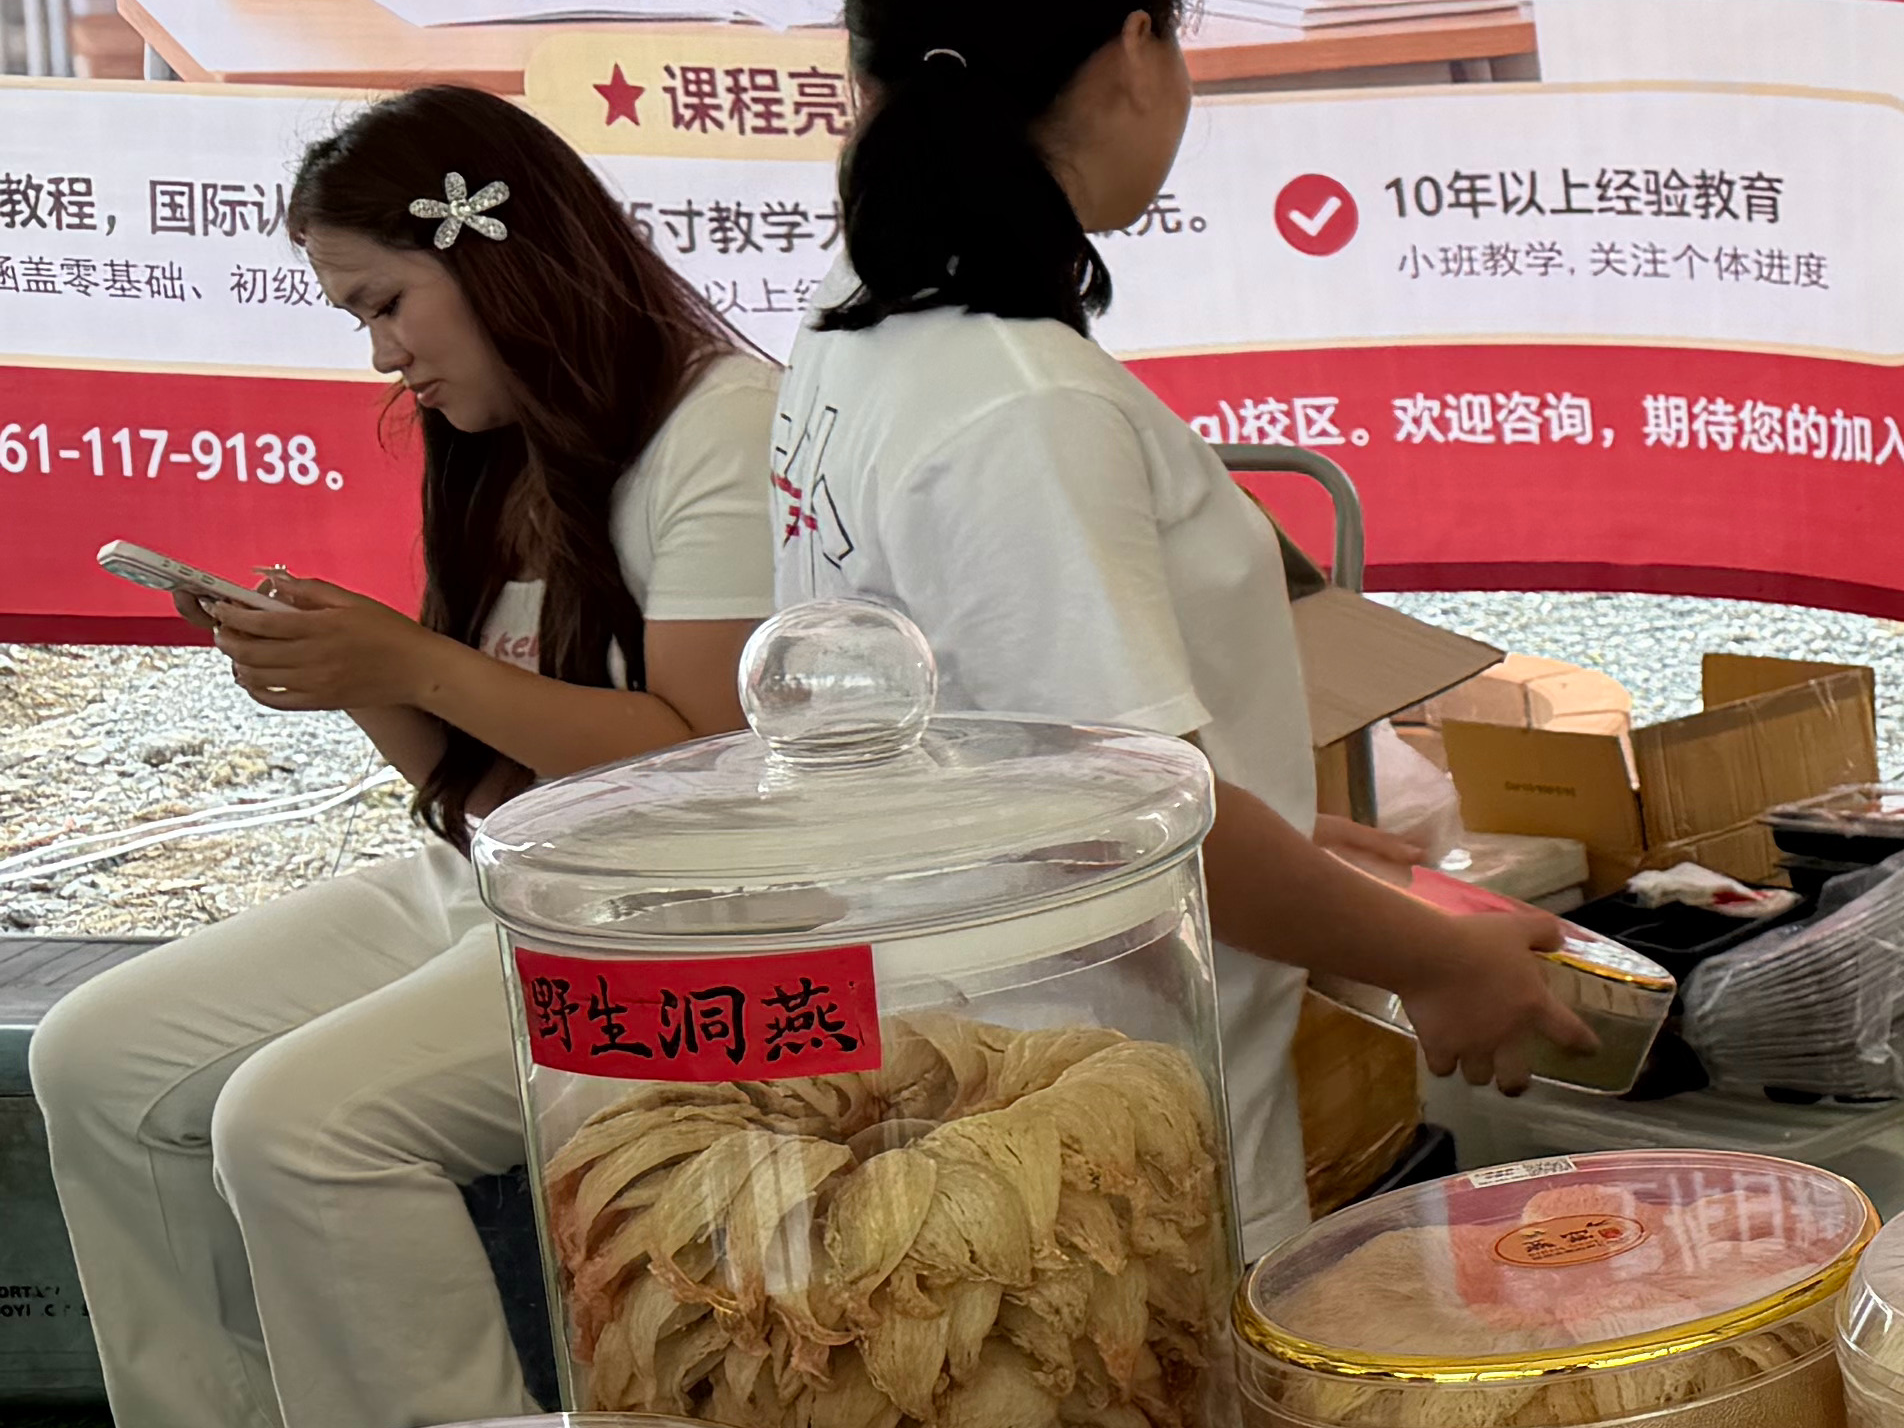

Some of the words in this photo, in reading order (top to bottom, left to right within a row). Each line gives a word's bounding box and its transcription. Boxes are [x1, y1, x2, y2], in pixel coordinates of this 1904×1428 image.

[1385, 168, 1785, 226] 10年以上经验教育
[0, 256, 330, 307] 盖零基础、初级
[531, 974, 859, 1066] 野生洞燕
